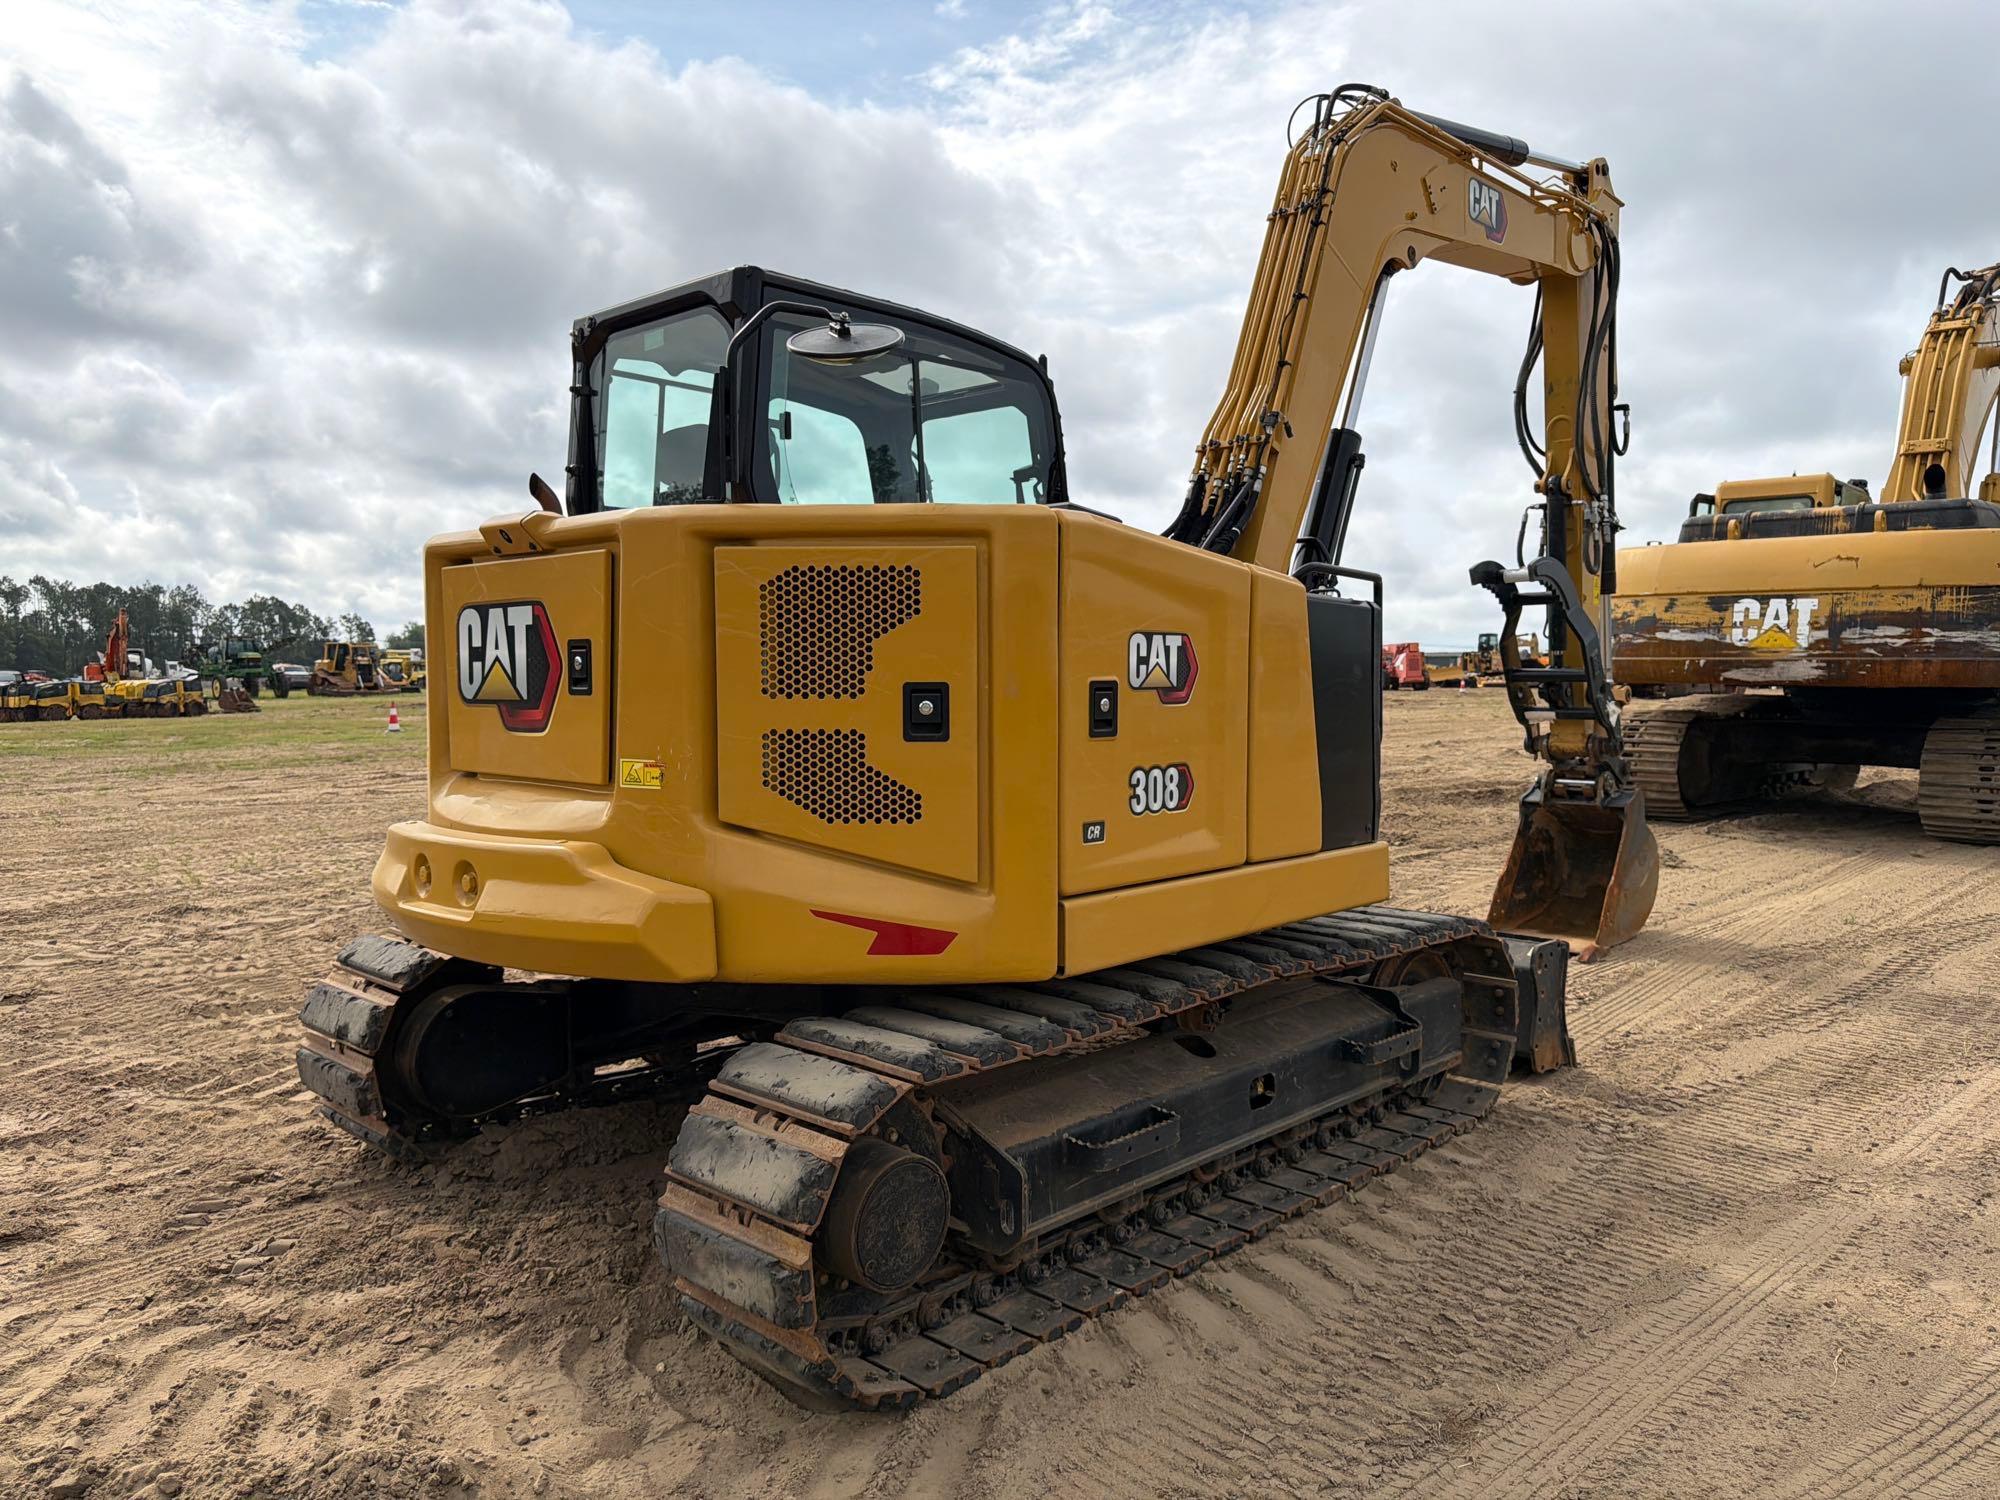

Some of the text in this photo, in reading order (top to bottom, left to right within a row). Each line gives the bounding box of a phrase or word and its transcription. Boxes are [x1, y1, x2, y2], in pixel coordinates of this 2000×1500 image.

[1469, 179, 1499, 229] CAT
[1731, 598, 1818, 648] CAT
[459, 605, 533, 700] CAT
[1129, 633, 1182, 687] CAT
[1130, 767, 1179, 813] 308
[1087, 825, 1101, 839] CR
